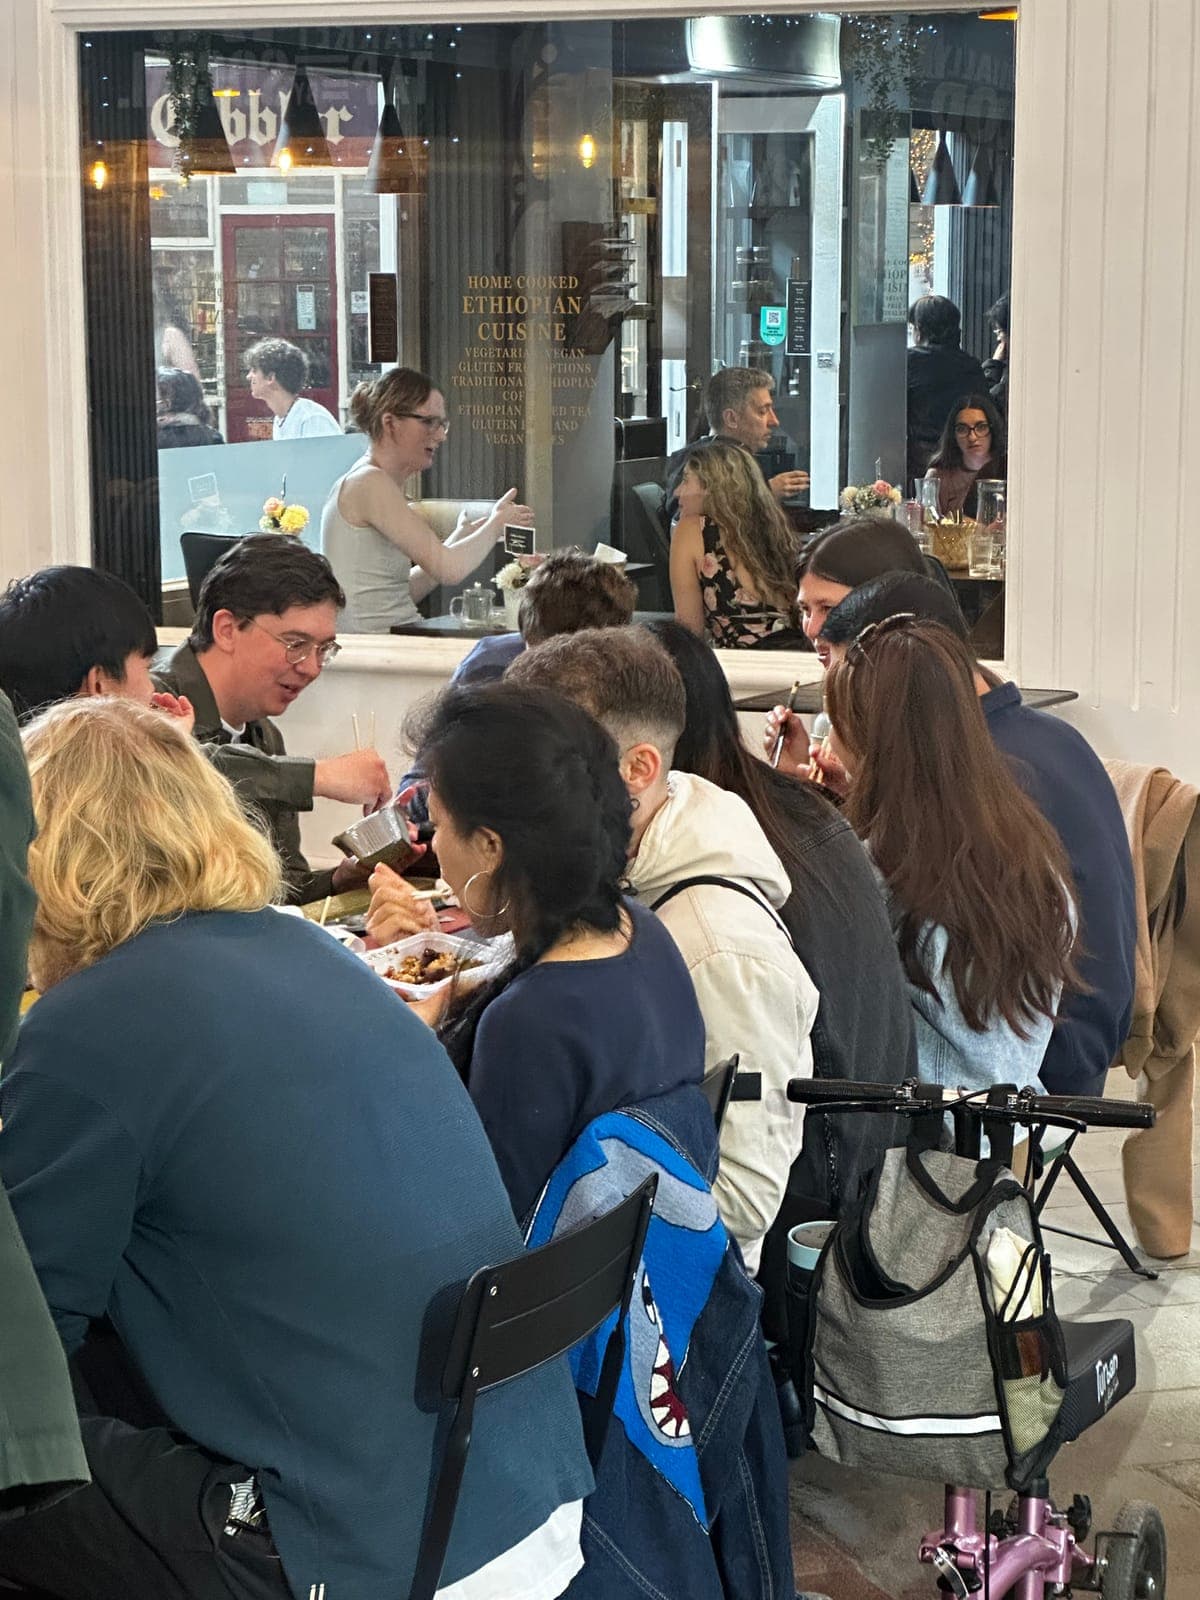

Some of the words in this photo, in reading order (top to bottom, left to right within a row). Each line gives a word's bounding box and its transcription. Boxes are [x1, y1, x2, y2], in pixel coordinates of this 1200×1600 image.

[150, 89, 354, 148] Cbbr
[468, 275, 512, 289] HOME
[517, 275, 579, 289] COOKED
[462, 295, 582, 315] ETHIOPIAN
[459, 362, 505, 374] GLUTEN
[537, 376, 598, 388] HIOPIAN
[459, 404, 522, 416] ETHIOPIAN
[472, 419, 518, 431] GLUTEN
[553, 420, 578, 432] AND
